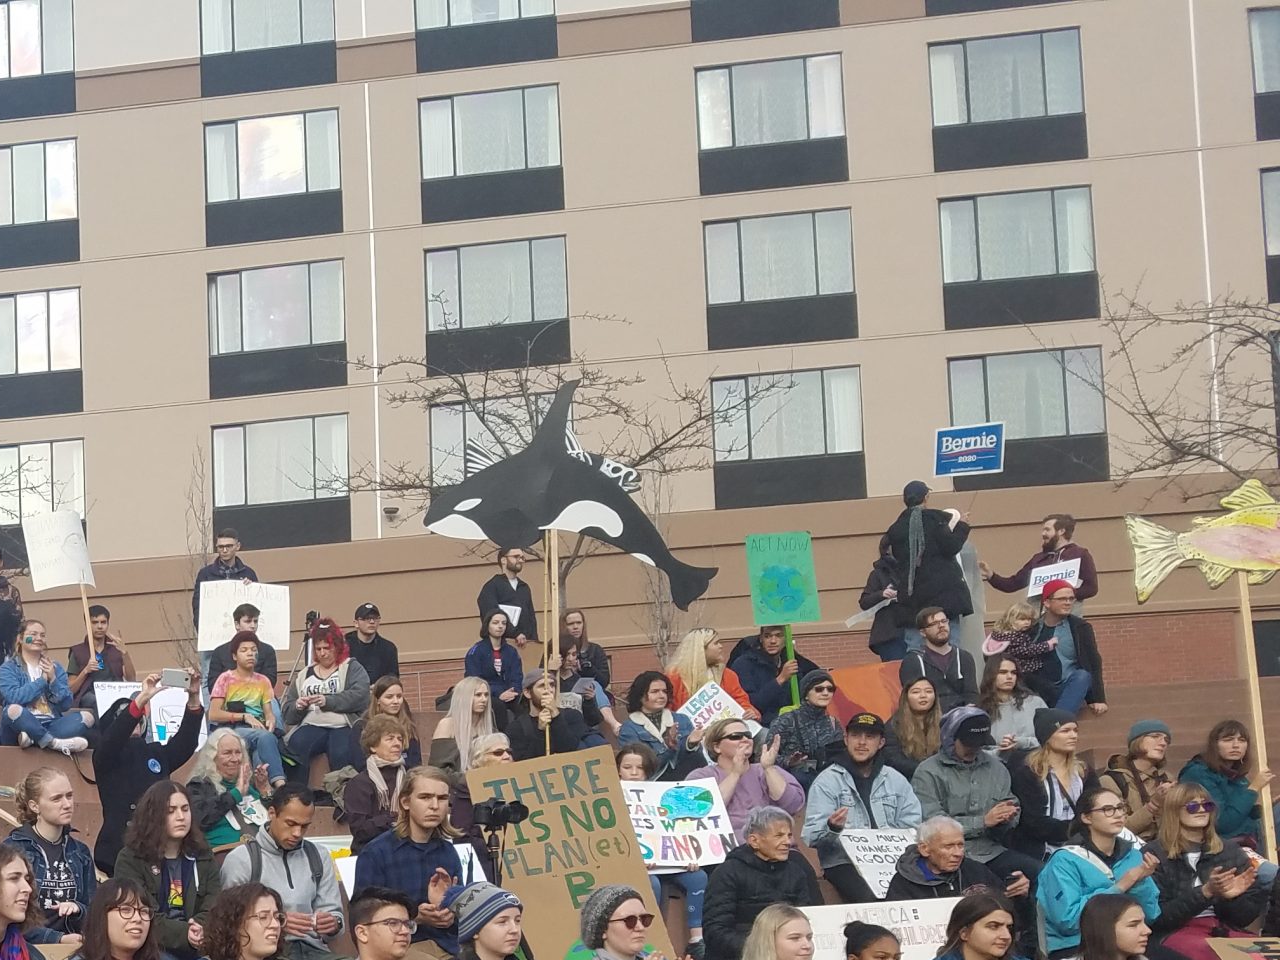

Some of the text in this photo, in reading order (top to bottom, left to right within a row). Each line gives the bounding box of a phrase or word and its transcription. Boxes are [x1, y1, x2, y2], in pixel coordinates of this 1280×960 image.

[941, 432, 997, 453] Bernie
[957, 455, 977, 463] 2020
[751, 537, 809, 552] ACT NOW
[1033, 569, 1076, 586] Bernie
[685, 683, 720, 716] LEVELS
[482, 759, 609, 804] THERE
[513, 798, 617, 846] IS NO
[842, 834, 908, 843] TOO MUCH
[856, 845, 893, 853] CHANGE
